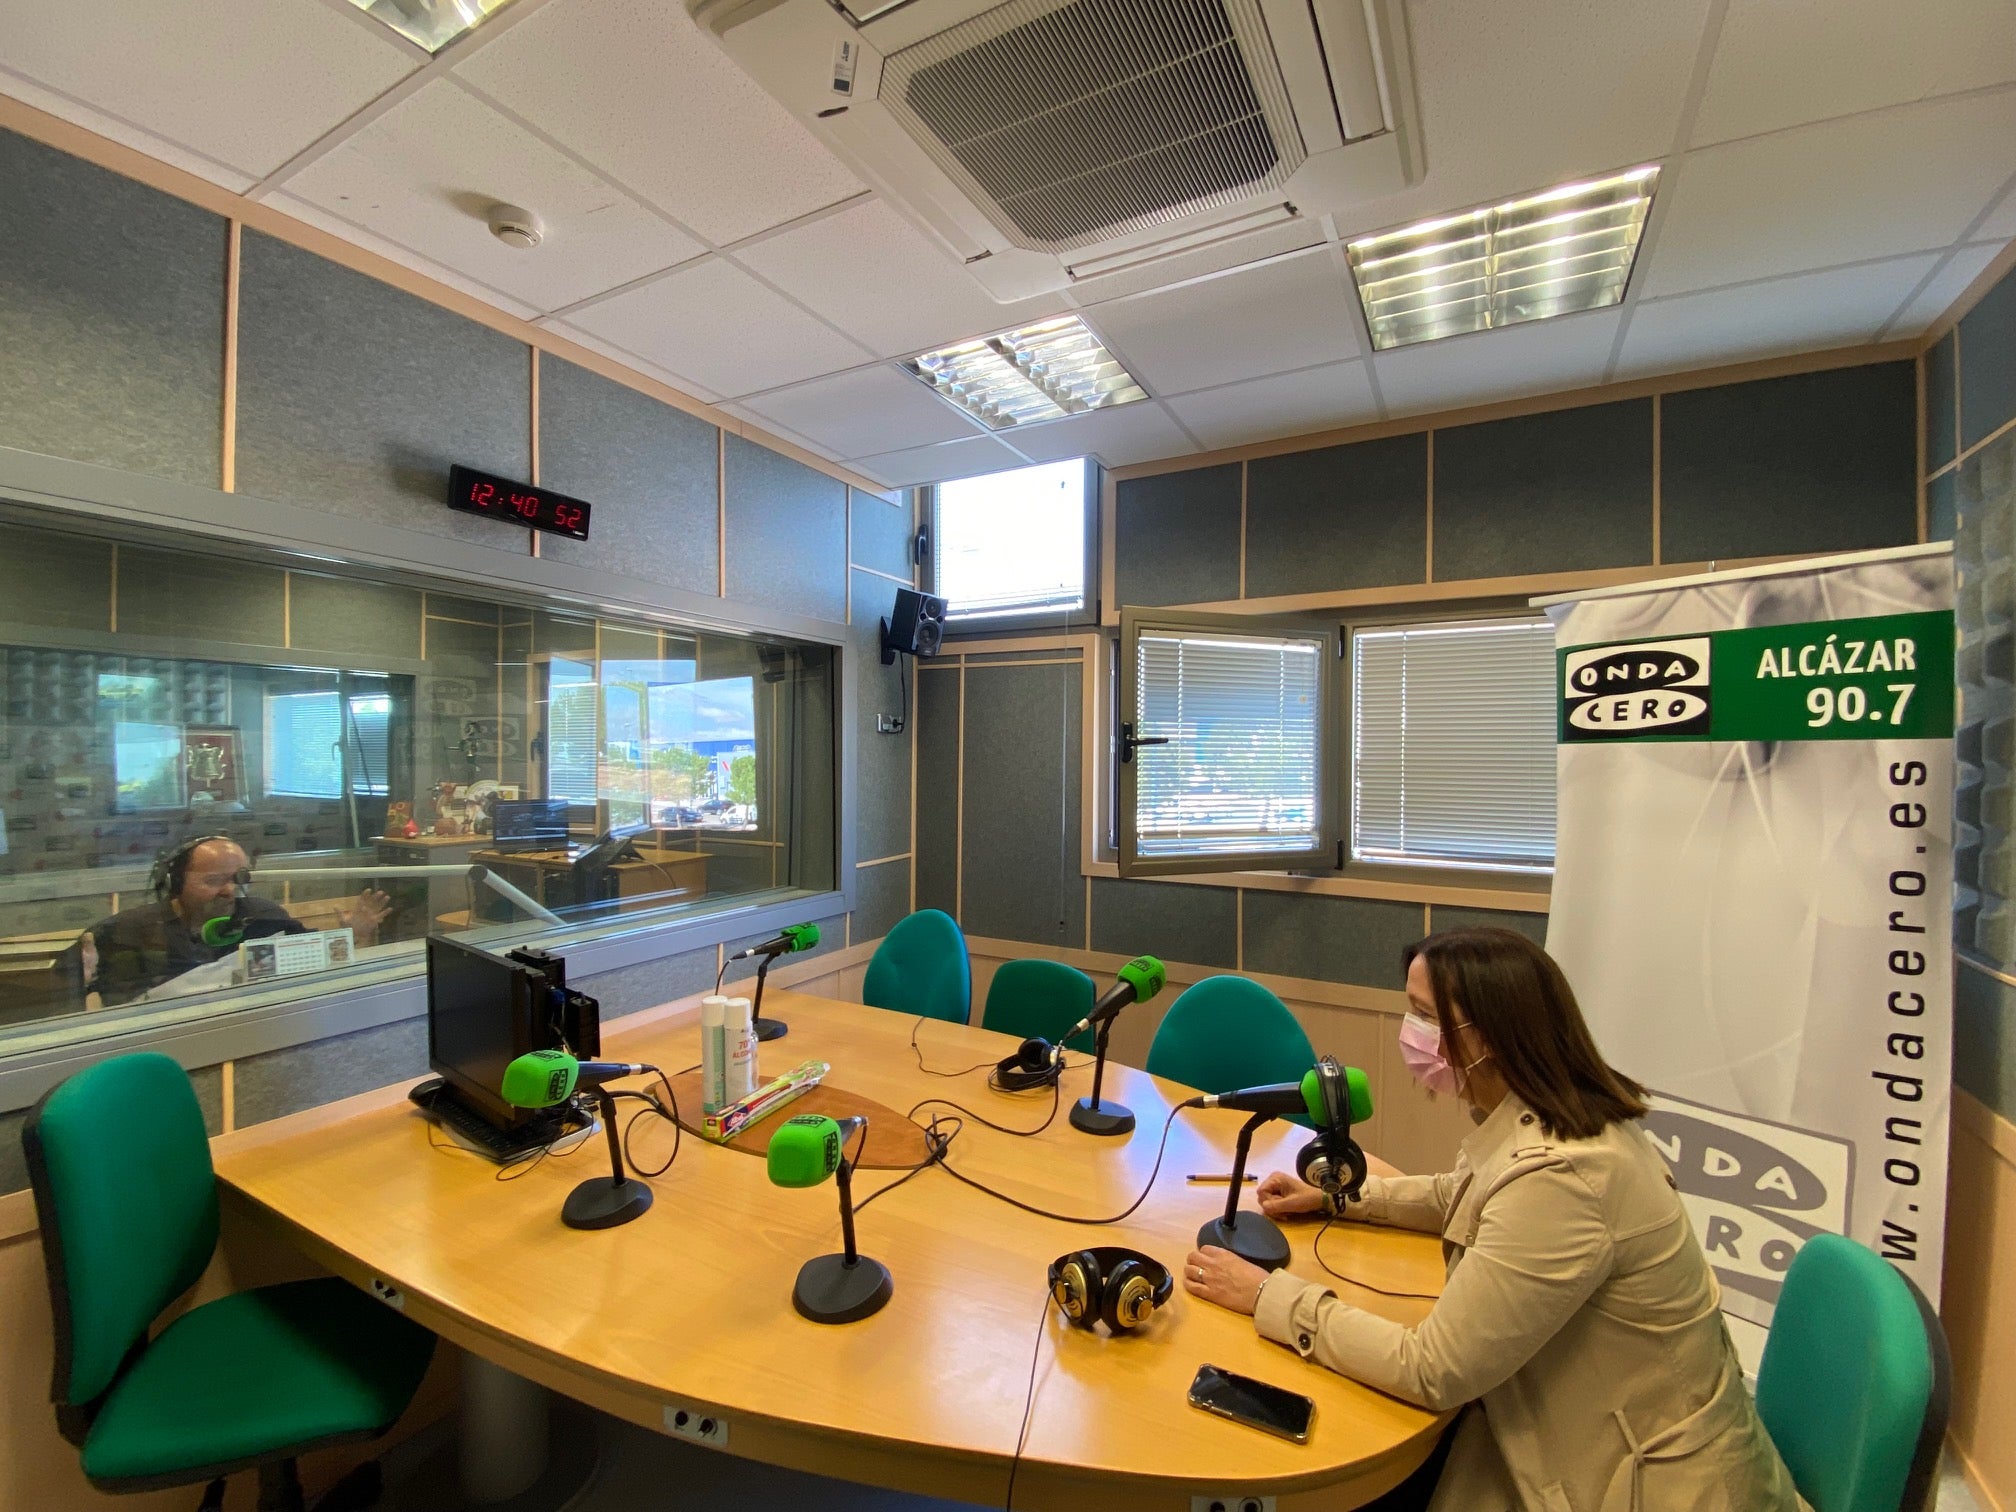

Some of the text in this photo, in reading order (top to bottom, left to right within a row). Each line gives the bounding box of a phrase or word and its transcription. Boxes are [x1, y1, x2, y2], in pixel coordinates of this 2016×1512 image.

[471, 483, 582, 528] 12:40 52
[1579, 659, 1687, 686] ONDA
[1756, 633, 1916, 679] ALCÁZAR
[1586, 698, 1687, 722] CERO
[1806, 683, 1916, 728] 90.7
[1871, 760, 1927, 1262] w.ondacero.es
[1644, 1128, 1798, 1201] NDA
[1705, 1214, 1797, 1273] RO
